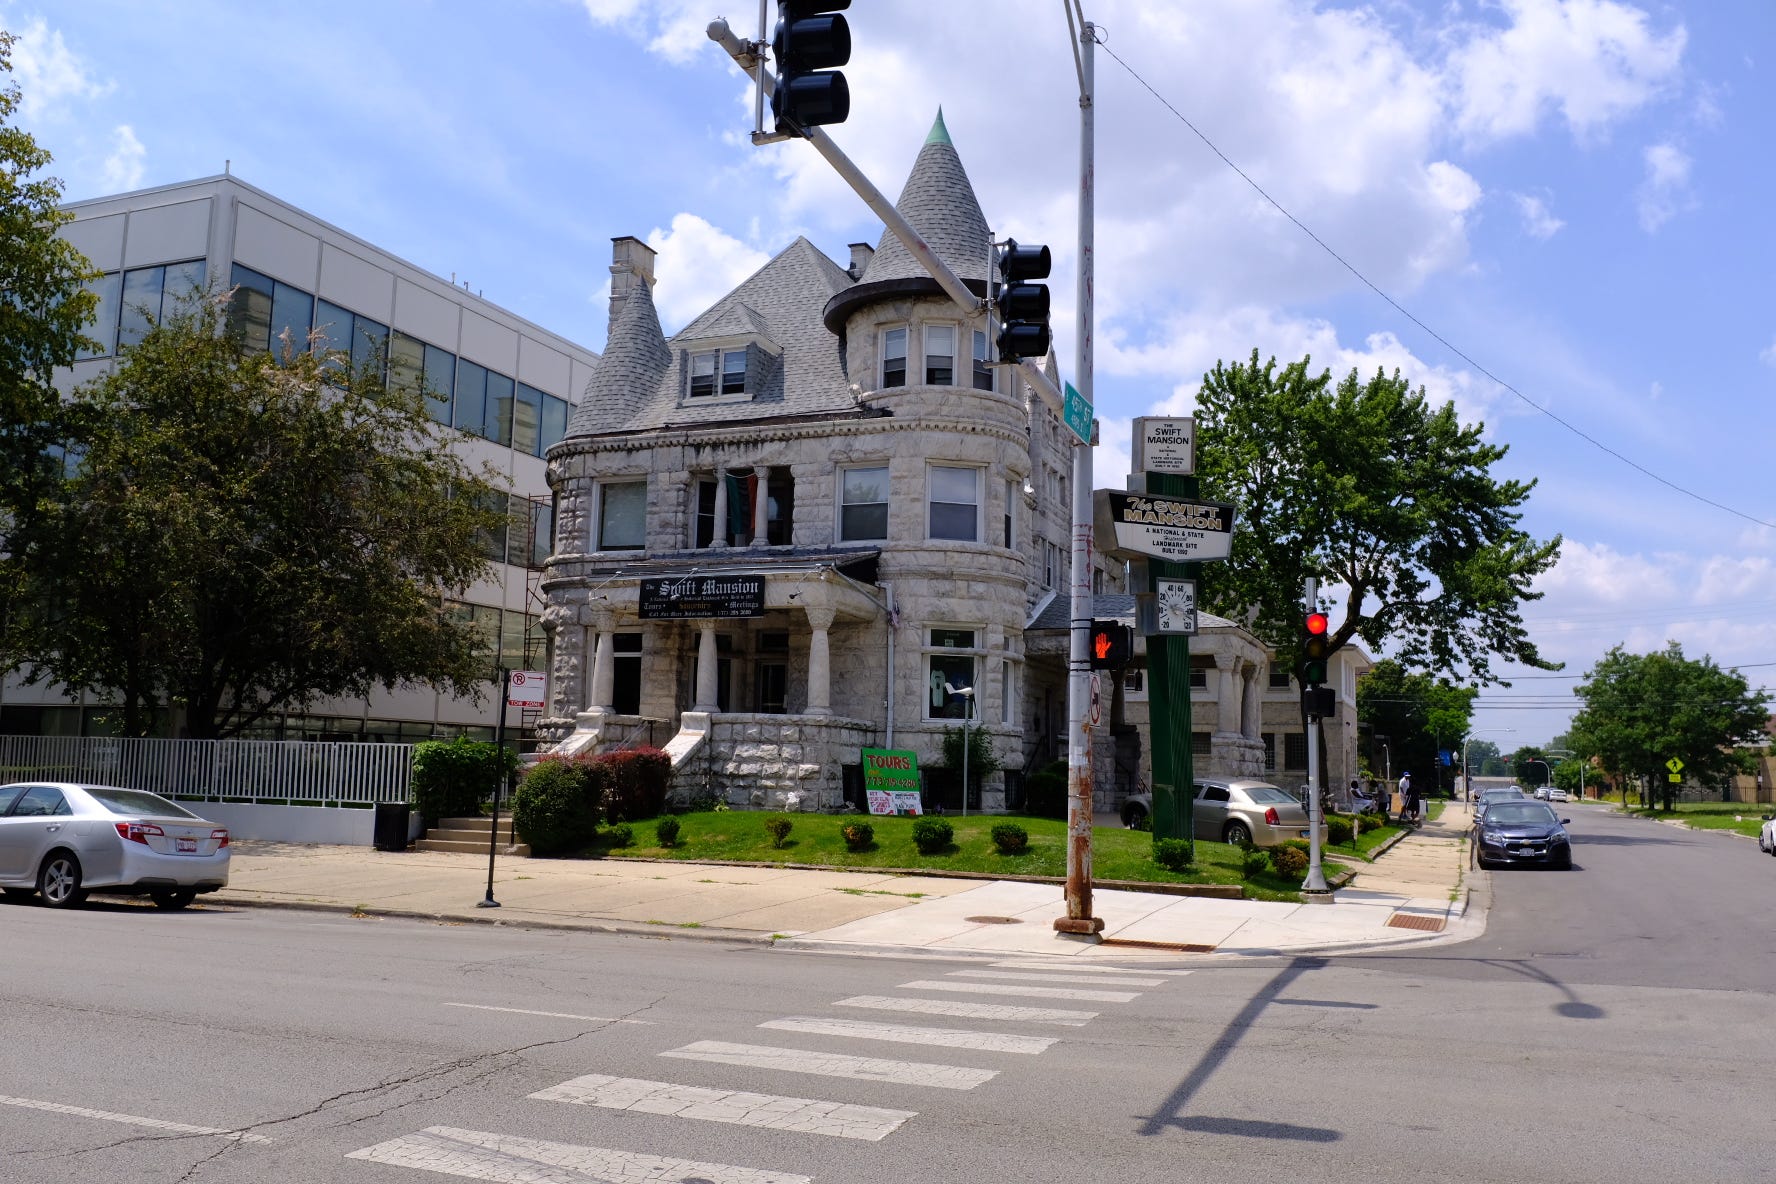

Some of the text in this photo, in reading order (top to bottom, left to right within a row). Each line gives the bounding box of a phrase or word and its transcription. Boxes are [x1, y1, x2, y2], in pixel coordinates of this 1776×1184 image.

[1084, 406, 1092, 424] ST
[1155, 428, 1182, 436] SWIFT
[1147, 436, 1189, 445] MANSION
[1127, 497, 1220, 518] The SWIFT
[1123, 509, 1223, 531] MANSION
[1152, 528, 1180, 536] NATIONAL
[1187, 531, 1205, 539] STATE
[1152, 540, 1184, 549] LANDMARK
[659, 580, 697, 597] Swift
[701, 578, 759, 595] Mansion
[1160, 592, 1193, 602] 20 80
[729, 601, 759, 610] Meetings
[865, 754, 912, 770] TOURS
